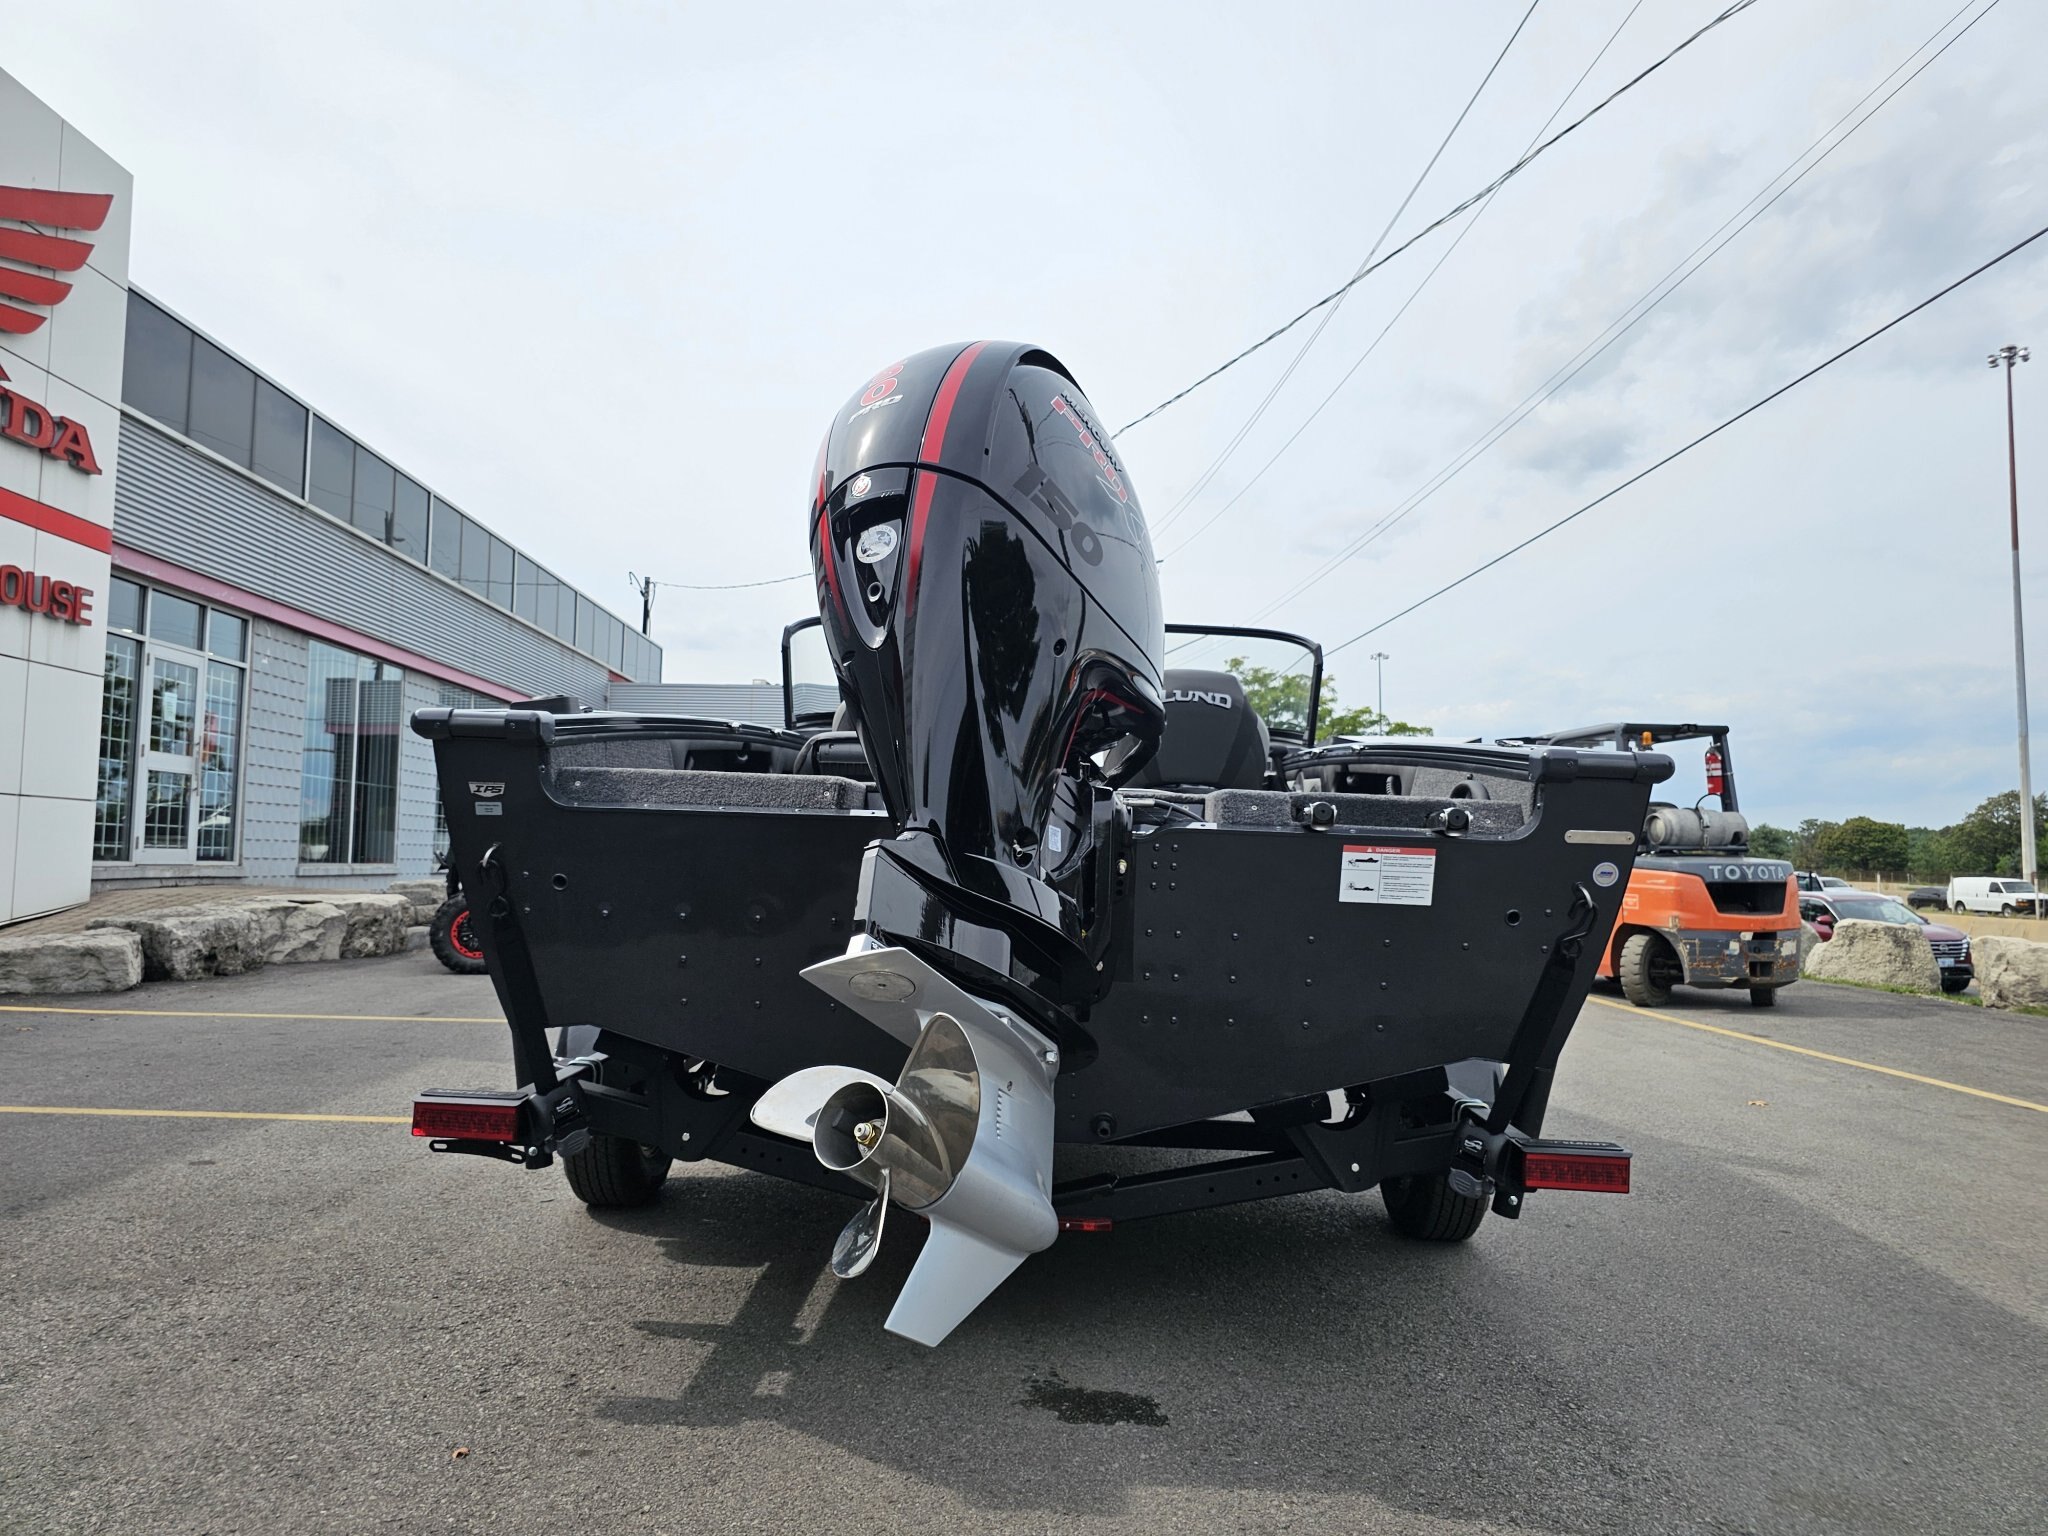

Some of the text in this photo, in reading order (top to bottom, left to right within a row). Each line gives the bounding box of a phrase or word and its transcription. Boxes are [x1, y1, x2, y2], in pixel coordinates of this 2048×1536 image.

[1059, 388, 1122, 473] MERCURY
[1012, 461, 1104, 567] 150
[0, 565, 94, 626] OUSE
[1161, 689, 1232, 709] LUND
[1708, 865, 1786, 880] TOYOTA
